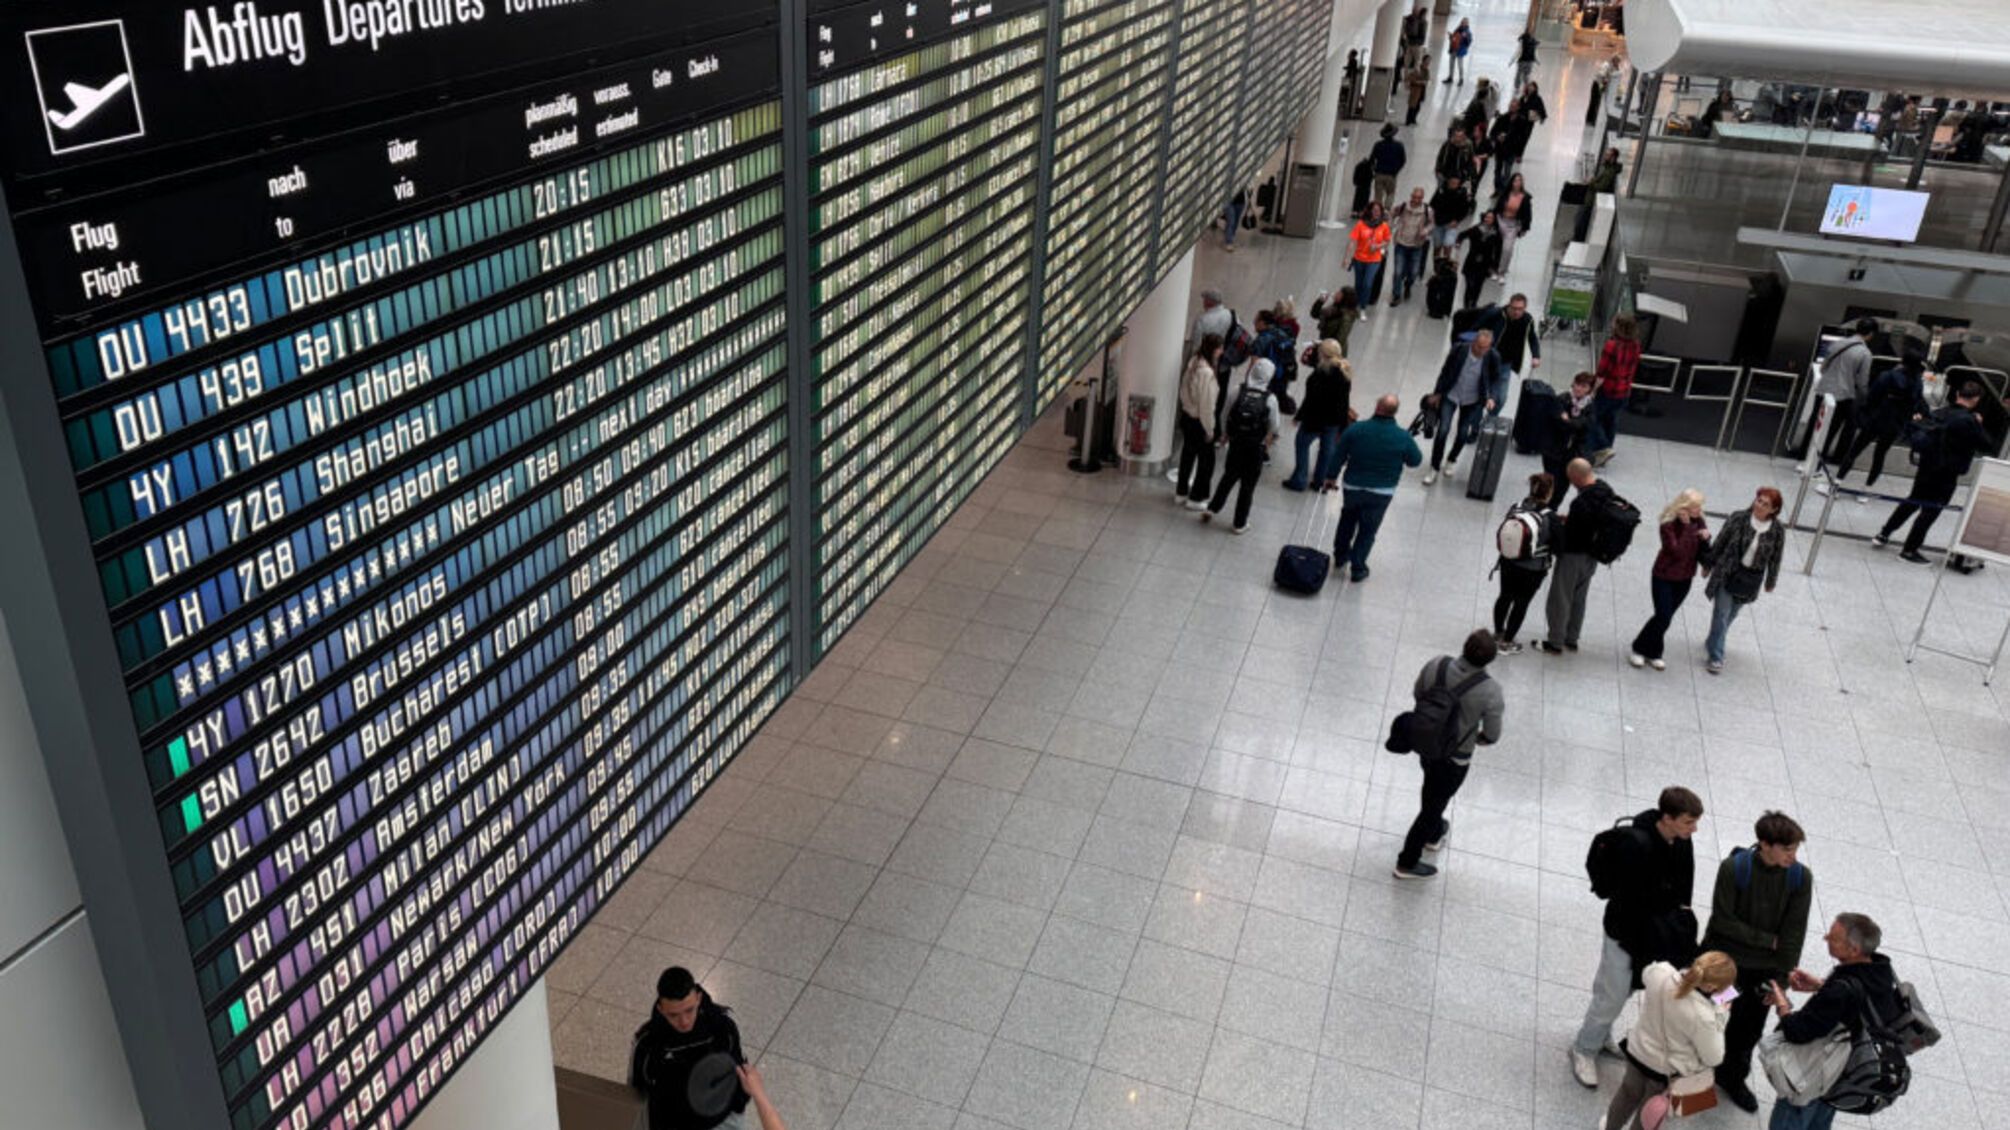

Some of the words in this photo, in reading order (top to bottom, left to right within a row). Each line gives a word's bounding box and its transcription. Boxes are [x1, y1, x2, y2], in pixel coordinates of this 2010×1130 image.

[184, 2, 307, 71] Abflug
[324, 0, 485, 51] Departures
[529, 125, 578, 158] scheduled
[596, 107, 639, 137] estimated
[652, 68, 672, 88] Gate
[71, 221, 119, 253] Flug
[268, 165, 307, 197] nach
[387, 139, 418, 163] über
[81, 261, 142, 299] Flight
[275, 216, 293, 238] to
[393, 176, 416, 200] via
[164, 285, 251, 354] 4433
[284, 222, 432, 311] Dubrovnik
[533, 166, 590, 219] 20:15
[656, 133, 684, 173] K16
[199, 353, 263, 414] 439
[294, 306, 380, 375] Split
[538, 218, 594, 272] 21:15
[129, 461, 178, 519] 4Y
[215, 417, 274, 479] 142
[305, 345, 433, 437] Windhoek
[543, 269, 598, 324] 21:40
[607, 243, 655, 294] 13:10
[144, 527, 191, 584] LH
[225, 479, 285, 542] 726
[315, 401, 439, 496] Shanghai
[548, 318, 602, 374] 22:20
[611, 289, 657, 341] 14:00
[158, 589, 204, 646] LH
[237, 539, 295, 602] 768
[324, 456, 460, 553] Singapore
[553, 365, 606, 423] 22:20
[614, 334, 660, 387] 13:45
[450, 477, 515, 536] Neuer
[524, 450, 559, 491] Tag
[598, 395, 636, 445] next
[644, 380, 671, 416] day
[185, 707, 229, 764] 4Y
[244, 651, 315, 725] 1270
[342, 574, 446, 661] Mikonos
[561, 456, 612, 516] 08:50
[620, 421, 665, 476] 09:40
[704, 364, 762, 420] boarding
[198, 763, 240, 819] SN
[253, 704, 324, 780] 2642
[351, 613, 465, 711] Brussels
[565, 499, 616, 560] 08:55
[623, 461, 667, 518] 09:20
[706, 401, 763, 458] boarding
[210, 816, 251, 872] VL
[266, 755, 333, 831] 1650
[359, 643, 482, 760] Bucharest
[569, 541, 619, 602] 08:55
[708, 426, 770, 496] cancelled
[274, 804, 341, 882] 4437
[367, 717, 451, 808] Zagreb
[572, 581, 621, 644] 08:55
[709, 462, 771, 533] cancelled
[233, 917, 272, 972] LH
[284, 852, 350, 930] 2302
[375, 739, 493, 854] Amsterdam
[576, 621, 624, 684] 09:00
[710, 496, 771, 569] cancelled
[255, 1011, 291, 1065] UA
[318, 943, 365, 1007] 031
[389, 811, 513, 941] Newark/New
[522, 756, 565, 818] York
[582, 696, 629, 761] 09:35
[636, 651, 677, 710] 11:45
[244, 965, 282, 1020] AZ
[309, 899, 357, 962] 451
[382, 823, 450, 898] Milan
[265, 1056, 300, 1110] LH
[312, 986, 373, 1064] 2228
[396, 906, 462, 983] Paris
[586, 733, 631, 798] 09:45
[274, 1099, 309, 1130] O
[335, 1027, 380, 1092] 352
[402, 934, 478, 1023] Warsaw
[589, 768, 634, 834] 09:55
[343, 1067, 387, 1130] 436
[409, 960, 494, 1062] Chicago
[592, 802, 636, 868] 10:00
[415, 968, 519, 1100] Frankfurt
